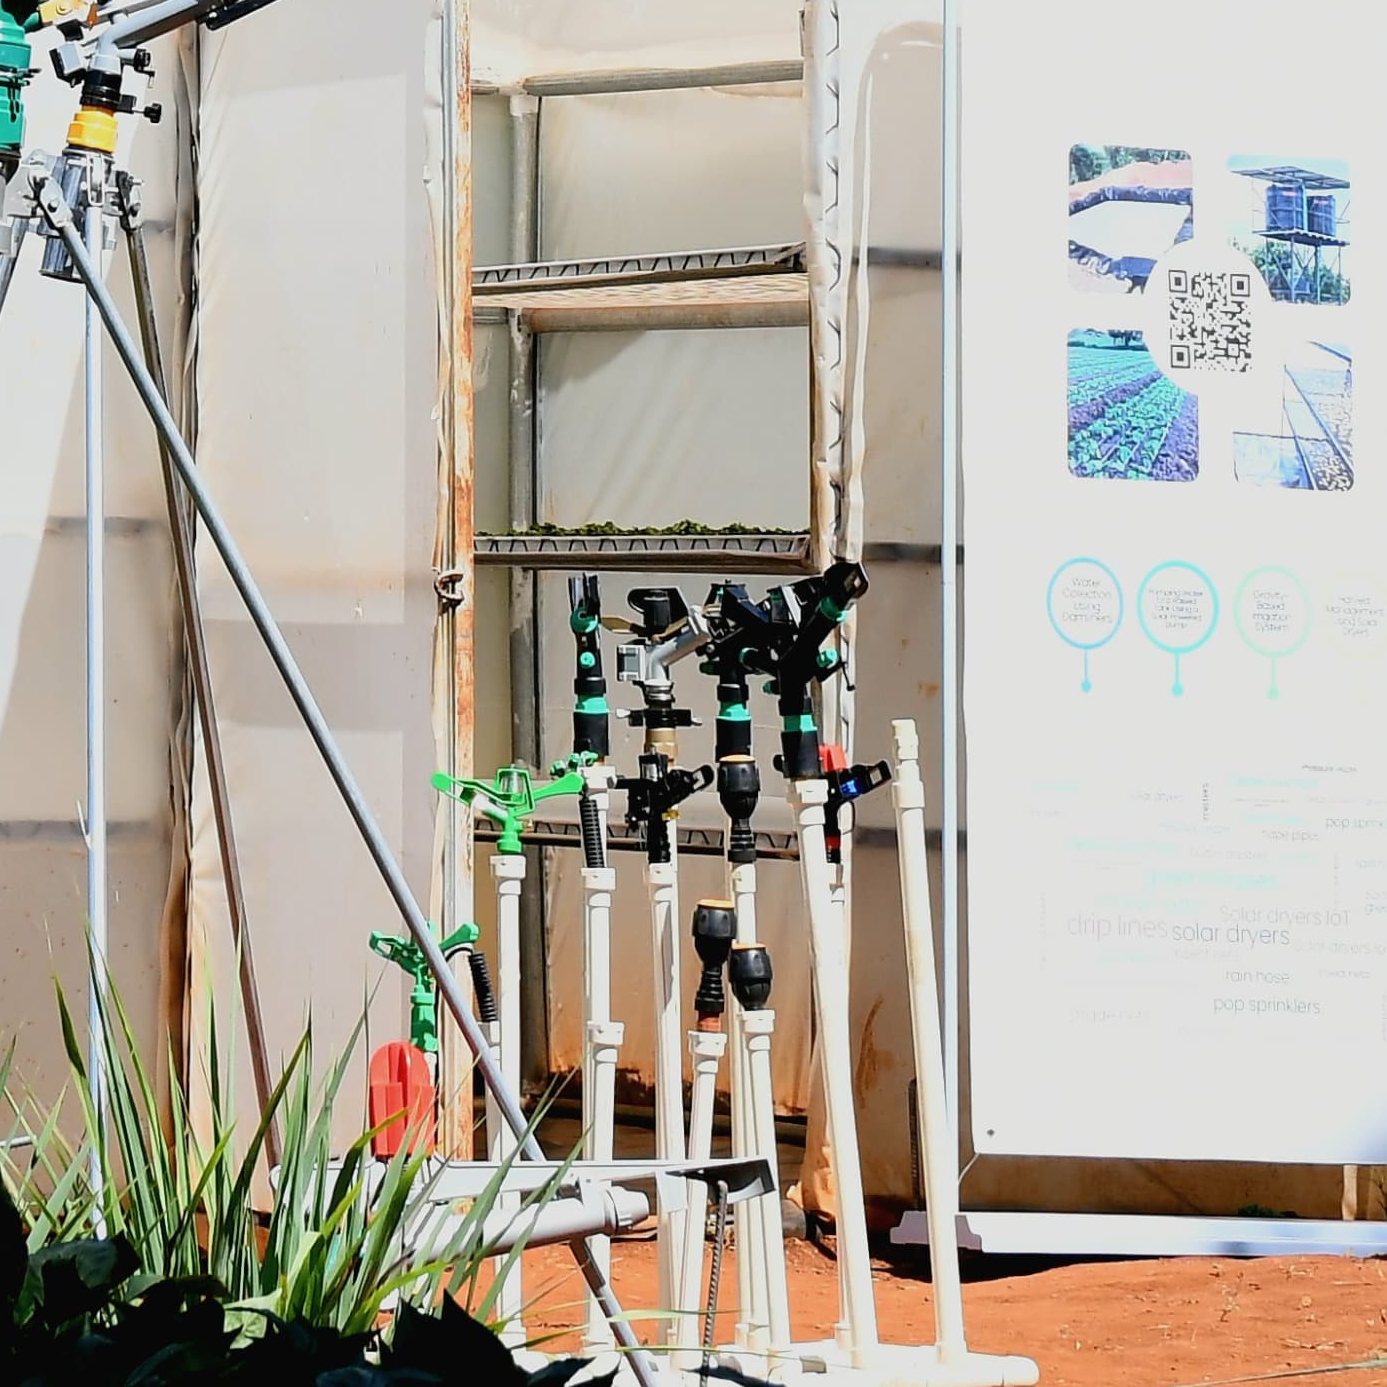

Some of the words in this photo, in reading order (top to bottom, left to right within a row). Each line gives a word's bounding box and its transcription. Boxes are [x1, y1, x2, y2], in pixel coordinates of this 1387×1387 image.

[1067, 911, 1112, 944] drip
[1117, 914, 1169, 940] lines
[1172, 922, 1219, 943] solar
[1226, 924, 1291, 949] dryers
[1224, 970, 1252, 983] rain
[1213, 997, 1245, 1015] pop
[1248, 996, 1321, 1016] sprinklers
